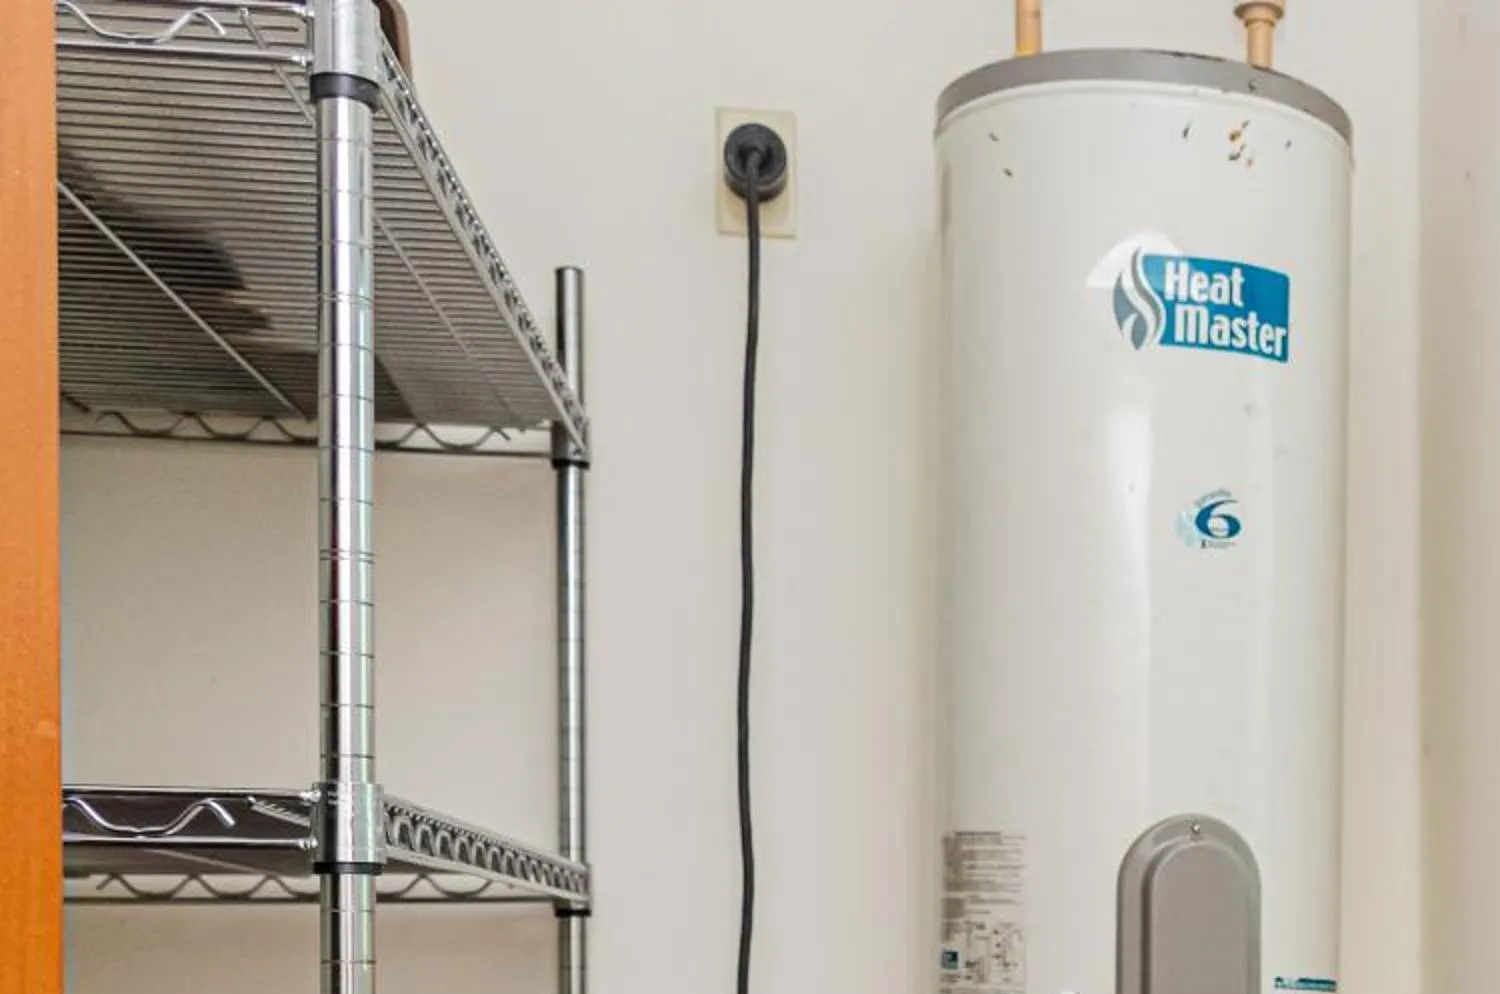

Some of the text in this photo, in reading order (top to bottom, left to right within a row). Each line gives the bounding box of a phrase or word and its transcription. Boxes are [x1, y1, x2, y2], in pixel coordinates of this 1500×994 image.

[1164, 261, 1245, 308] Heat
[1173, 303, 1288, 357] Master
[1195, 499, 1241, 539] 6
